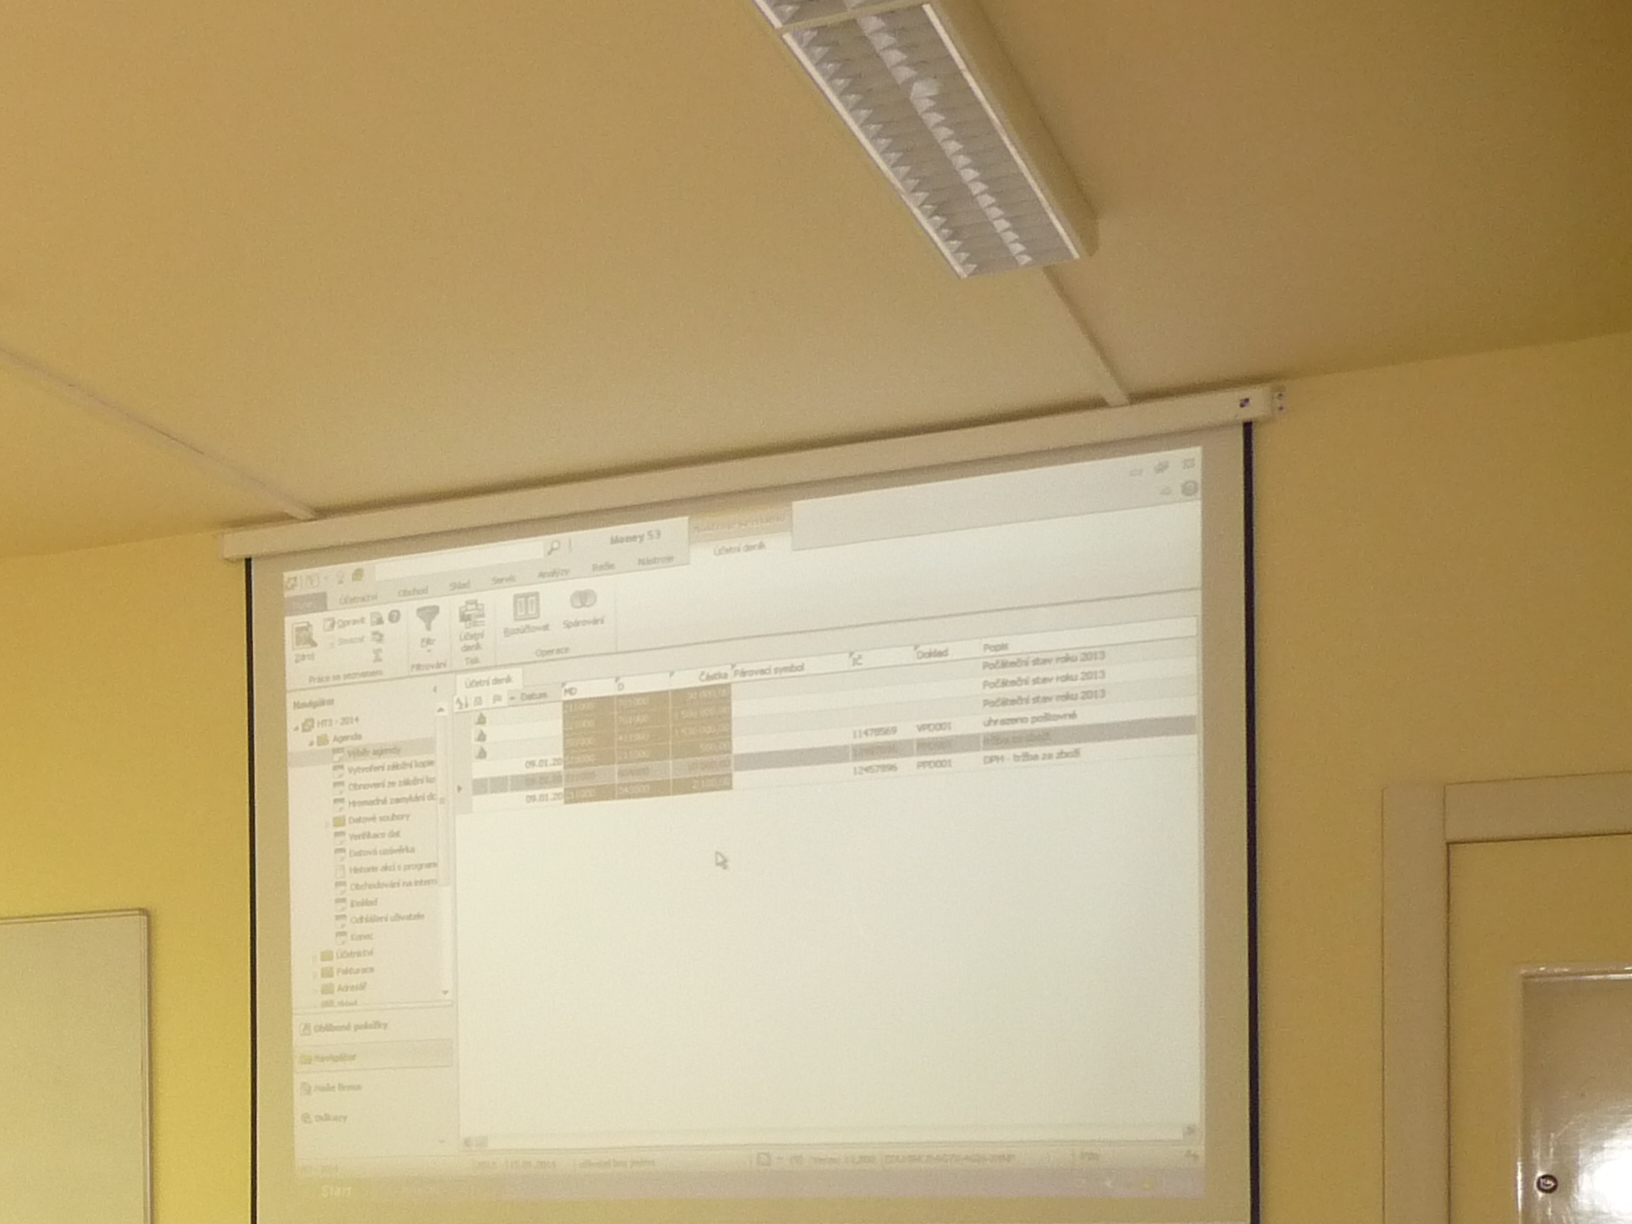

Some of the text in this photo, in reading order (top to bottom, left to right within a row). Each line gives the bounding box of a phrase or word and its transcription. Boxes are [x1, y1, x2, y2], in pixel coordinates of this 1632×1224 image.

[1080, 650, 1106, 662] 2013
[1080, 670, 1106, 681] 2013
[1080, 689, 1106, 700] 2013
